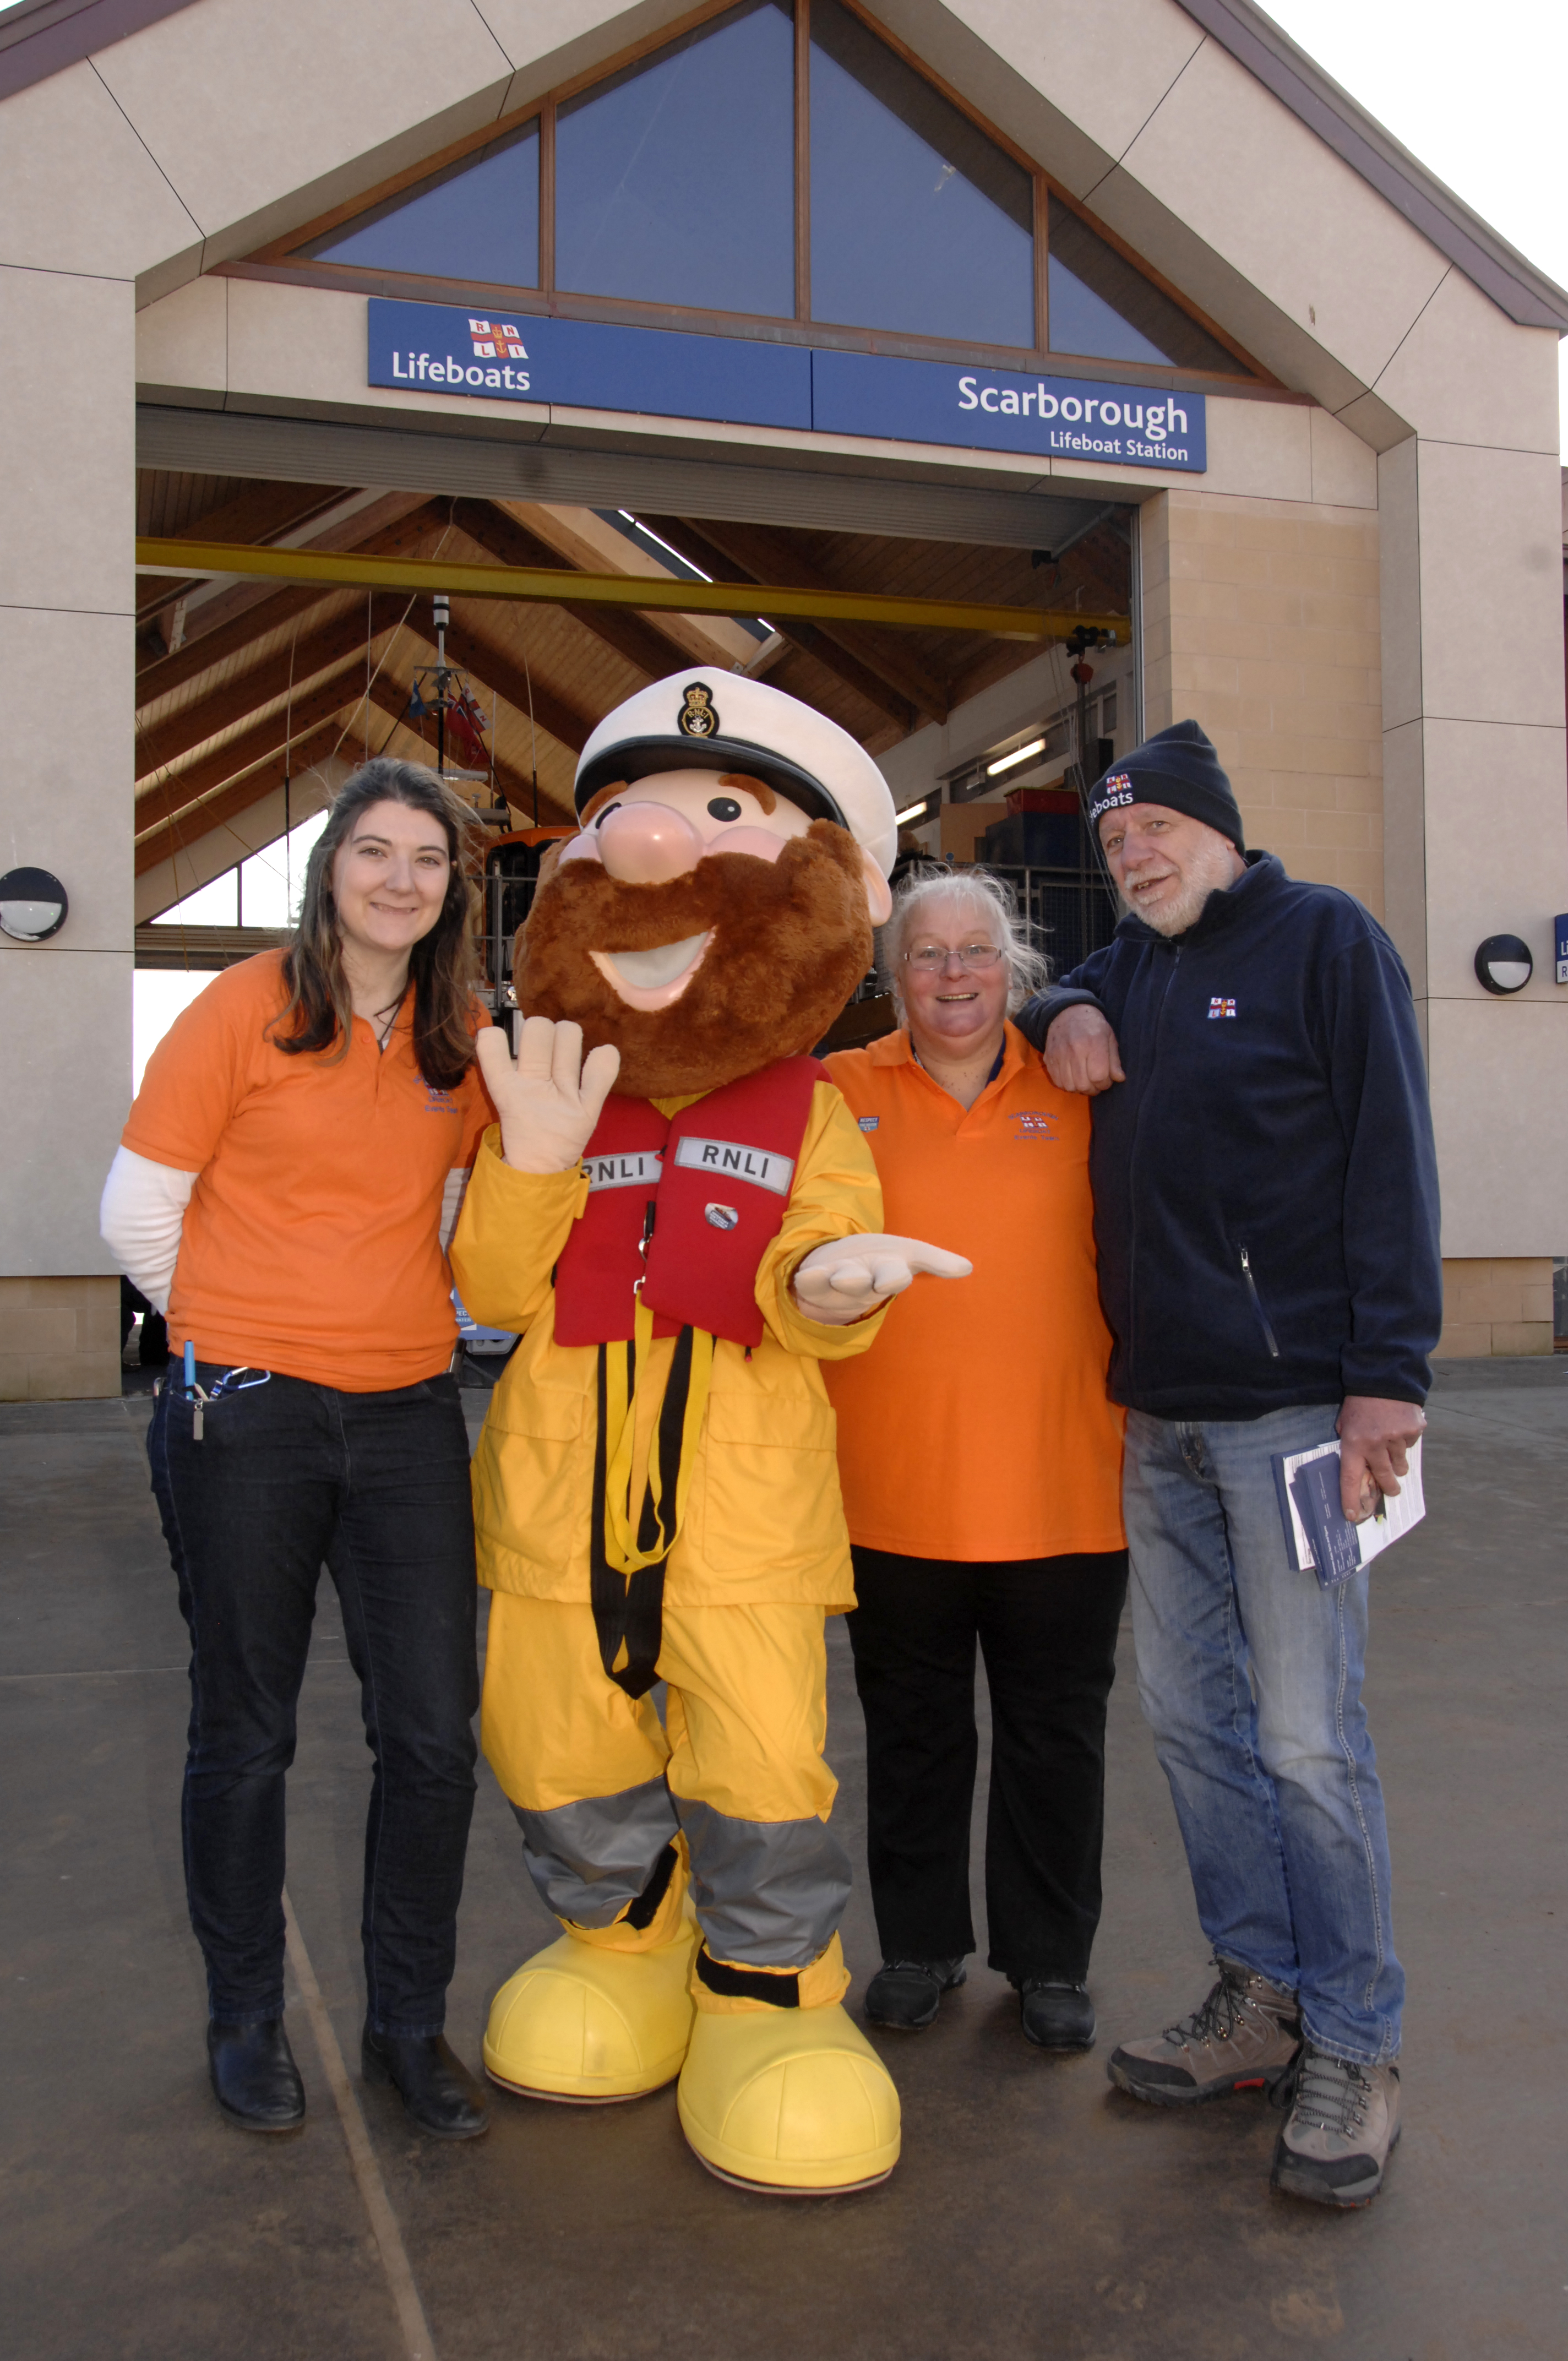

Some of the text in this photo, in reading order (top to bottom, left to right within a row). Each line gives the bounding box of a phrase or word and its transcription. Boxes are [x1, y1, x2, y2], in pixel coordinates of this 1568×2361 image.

[393, 352, 530, 390] Lifeboats
[958, 377, 1188, 440] Scarborough
[1050, 432, 1188, 461] Lifeboat Station
[702, 1144, 769, 1179] RNLI
